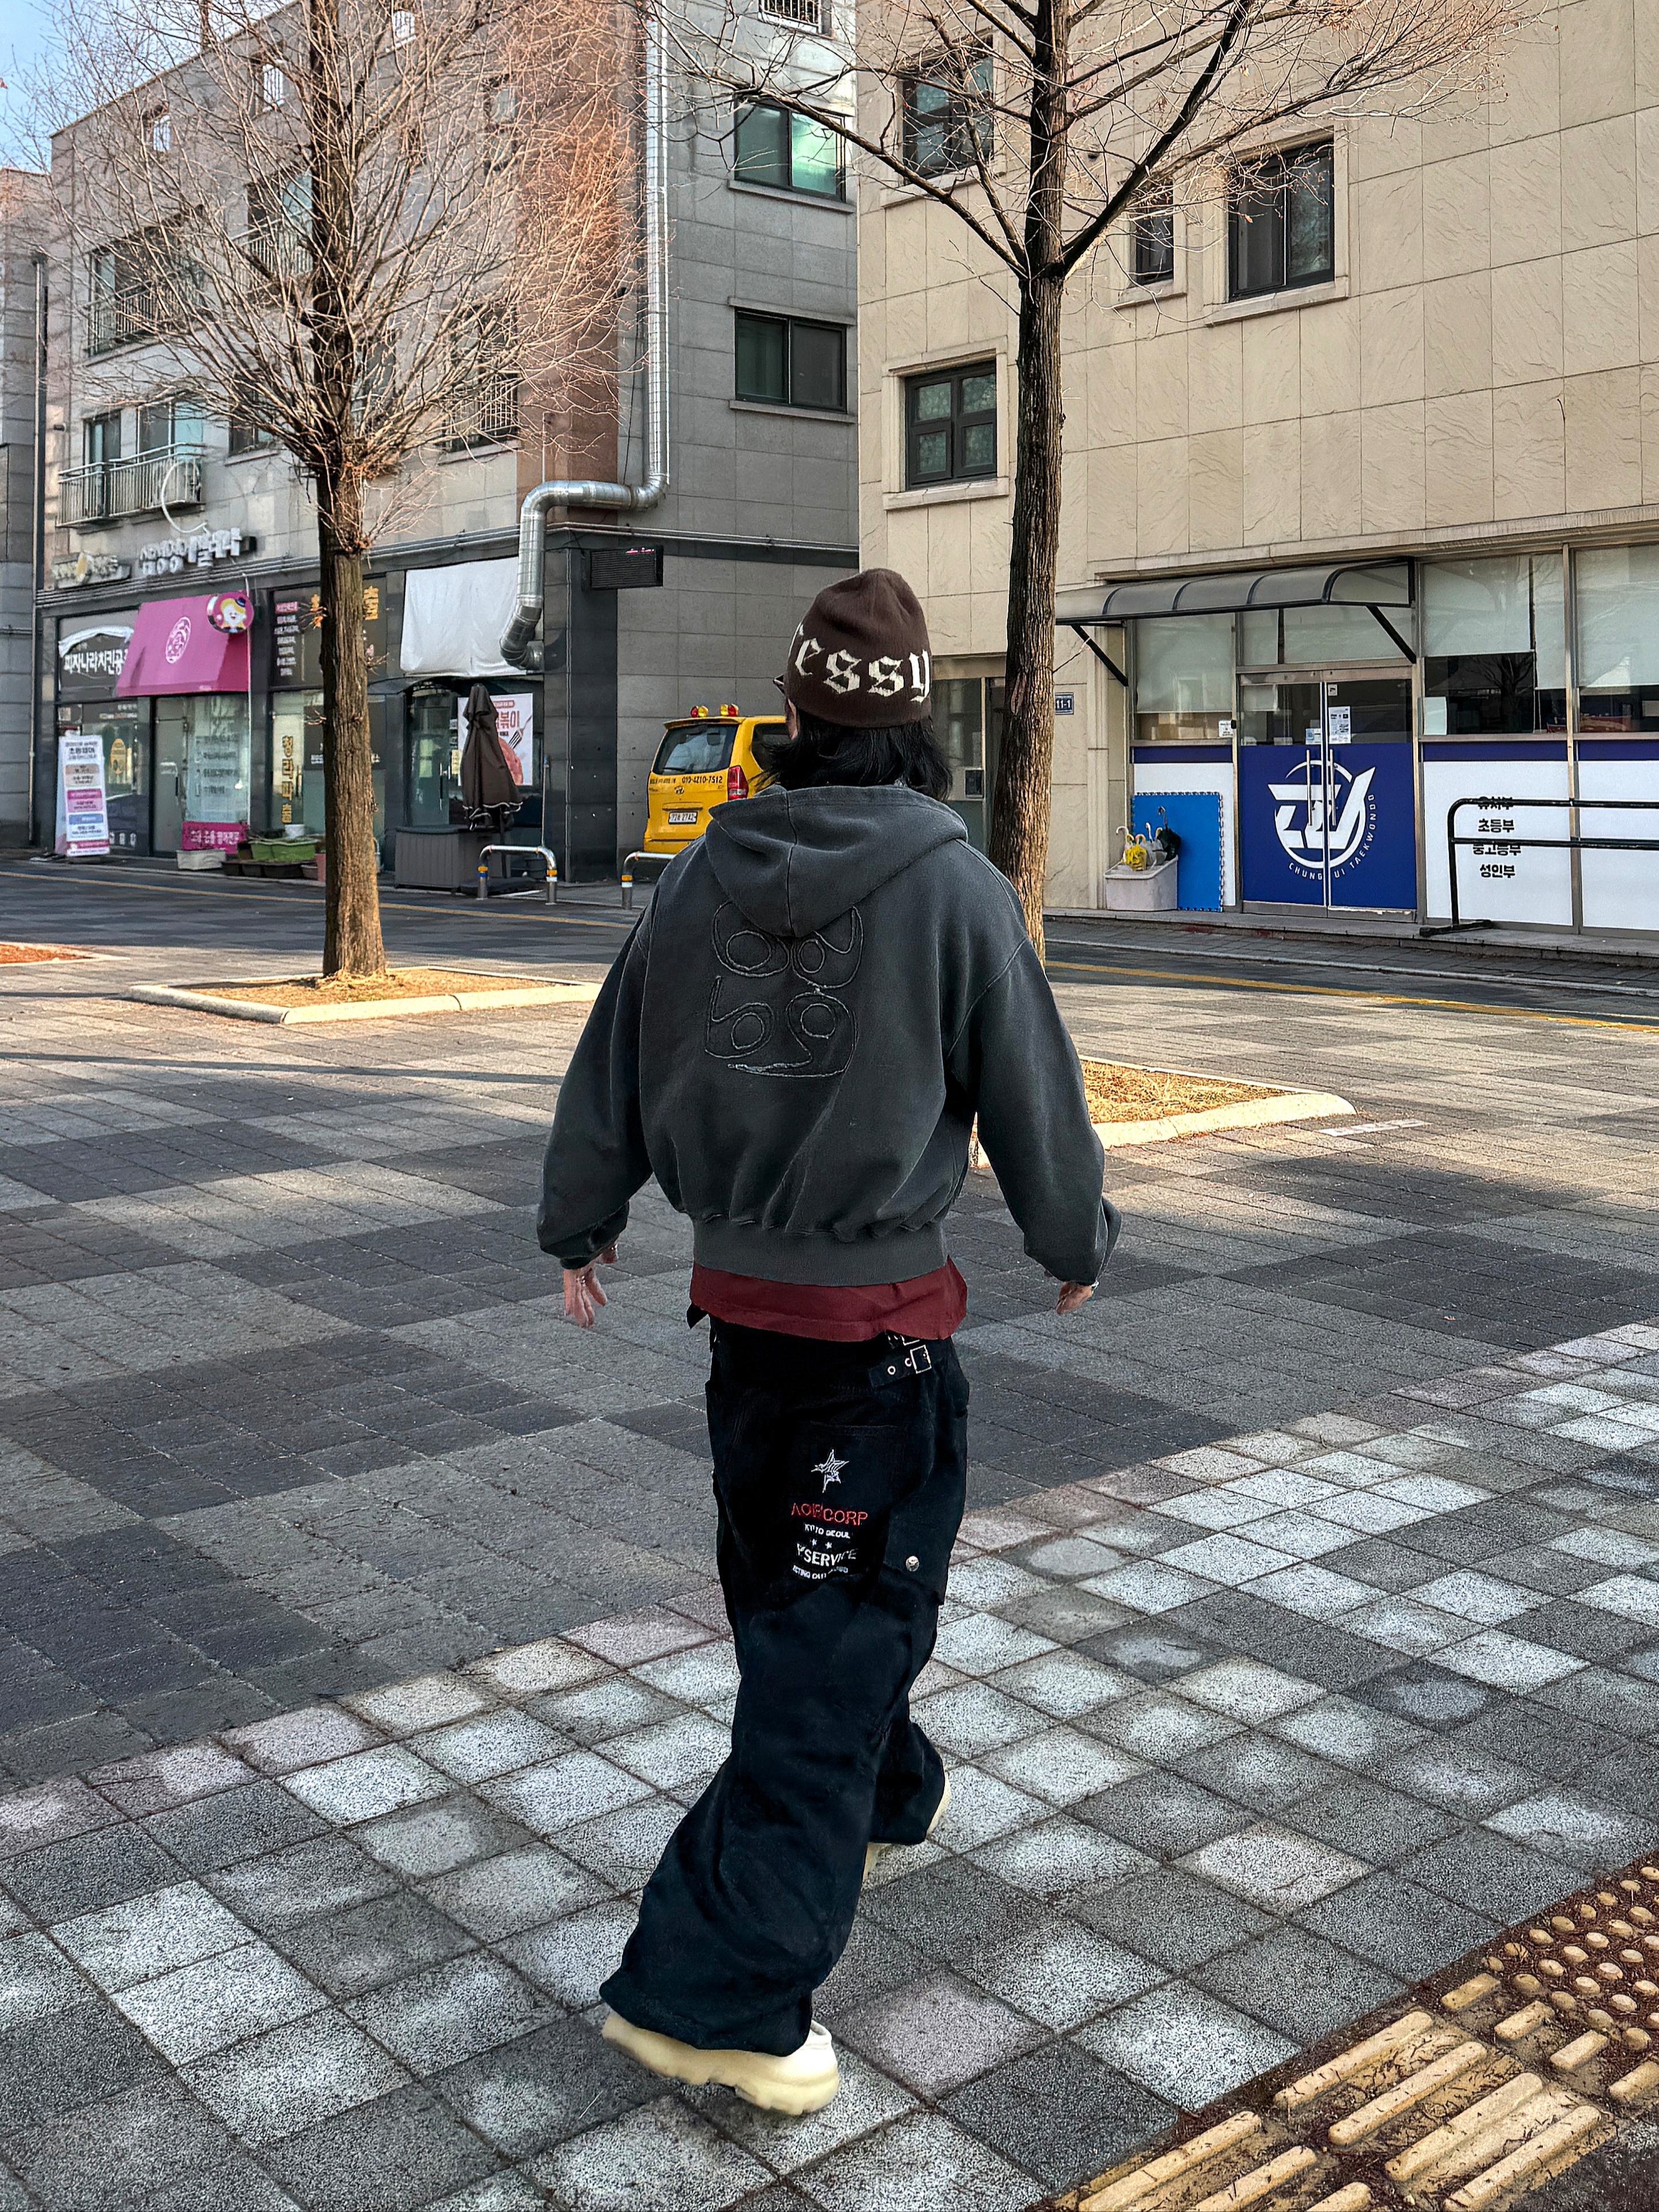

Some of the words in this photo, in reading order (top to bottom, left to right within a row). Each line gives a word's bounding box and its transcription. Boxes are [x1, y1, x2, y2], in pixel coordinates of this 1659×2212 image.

[64, 648, 128, 676] 피자나라치킨공
[788, 621, 931, 704] essy
[496, 711, 520, 730] 볶이
[1478, 818, 1515, 833] 초등부
[1288, 862, 1323, 881] CHUNG
[1334, 868, 1345, 879] UI
[1349, 794, 1376, 869] TAEKWONDO
[1479, 864, 1515, 878] 성인부
